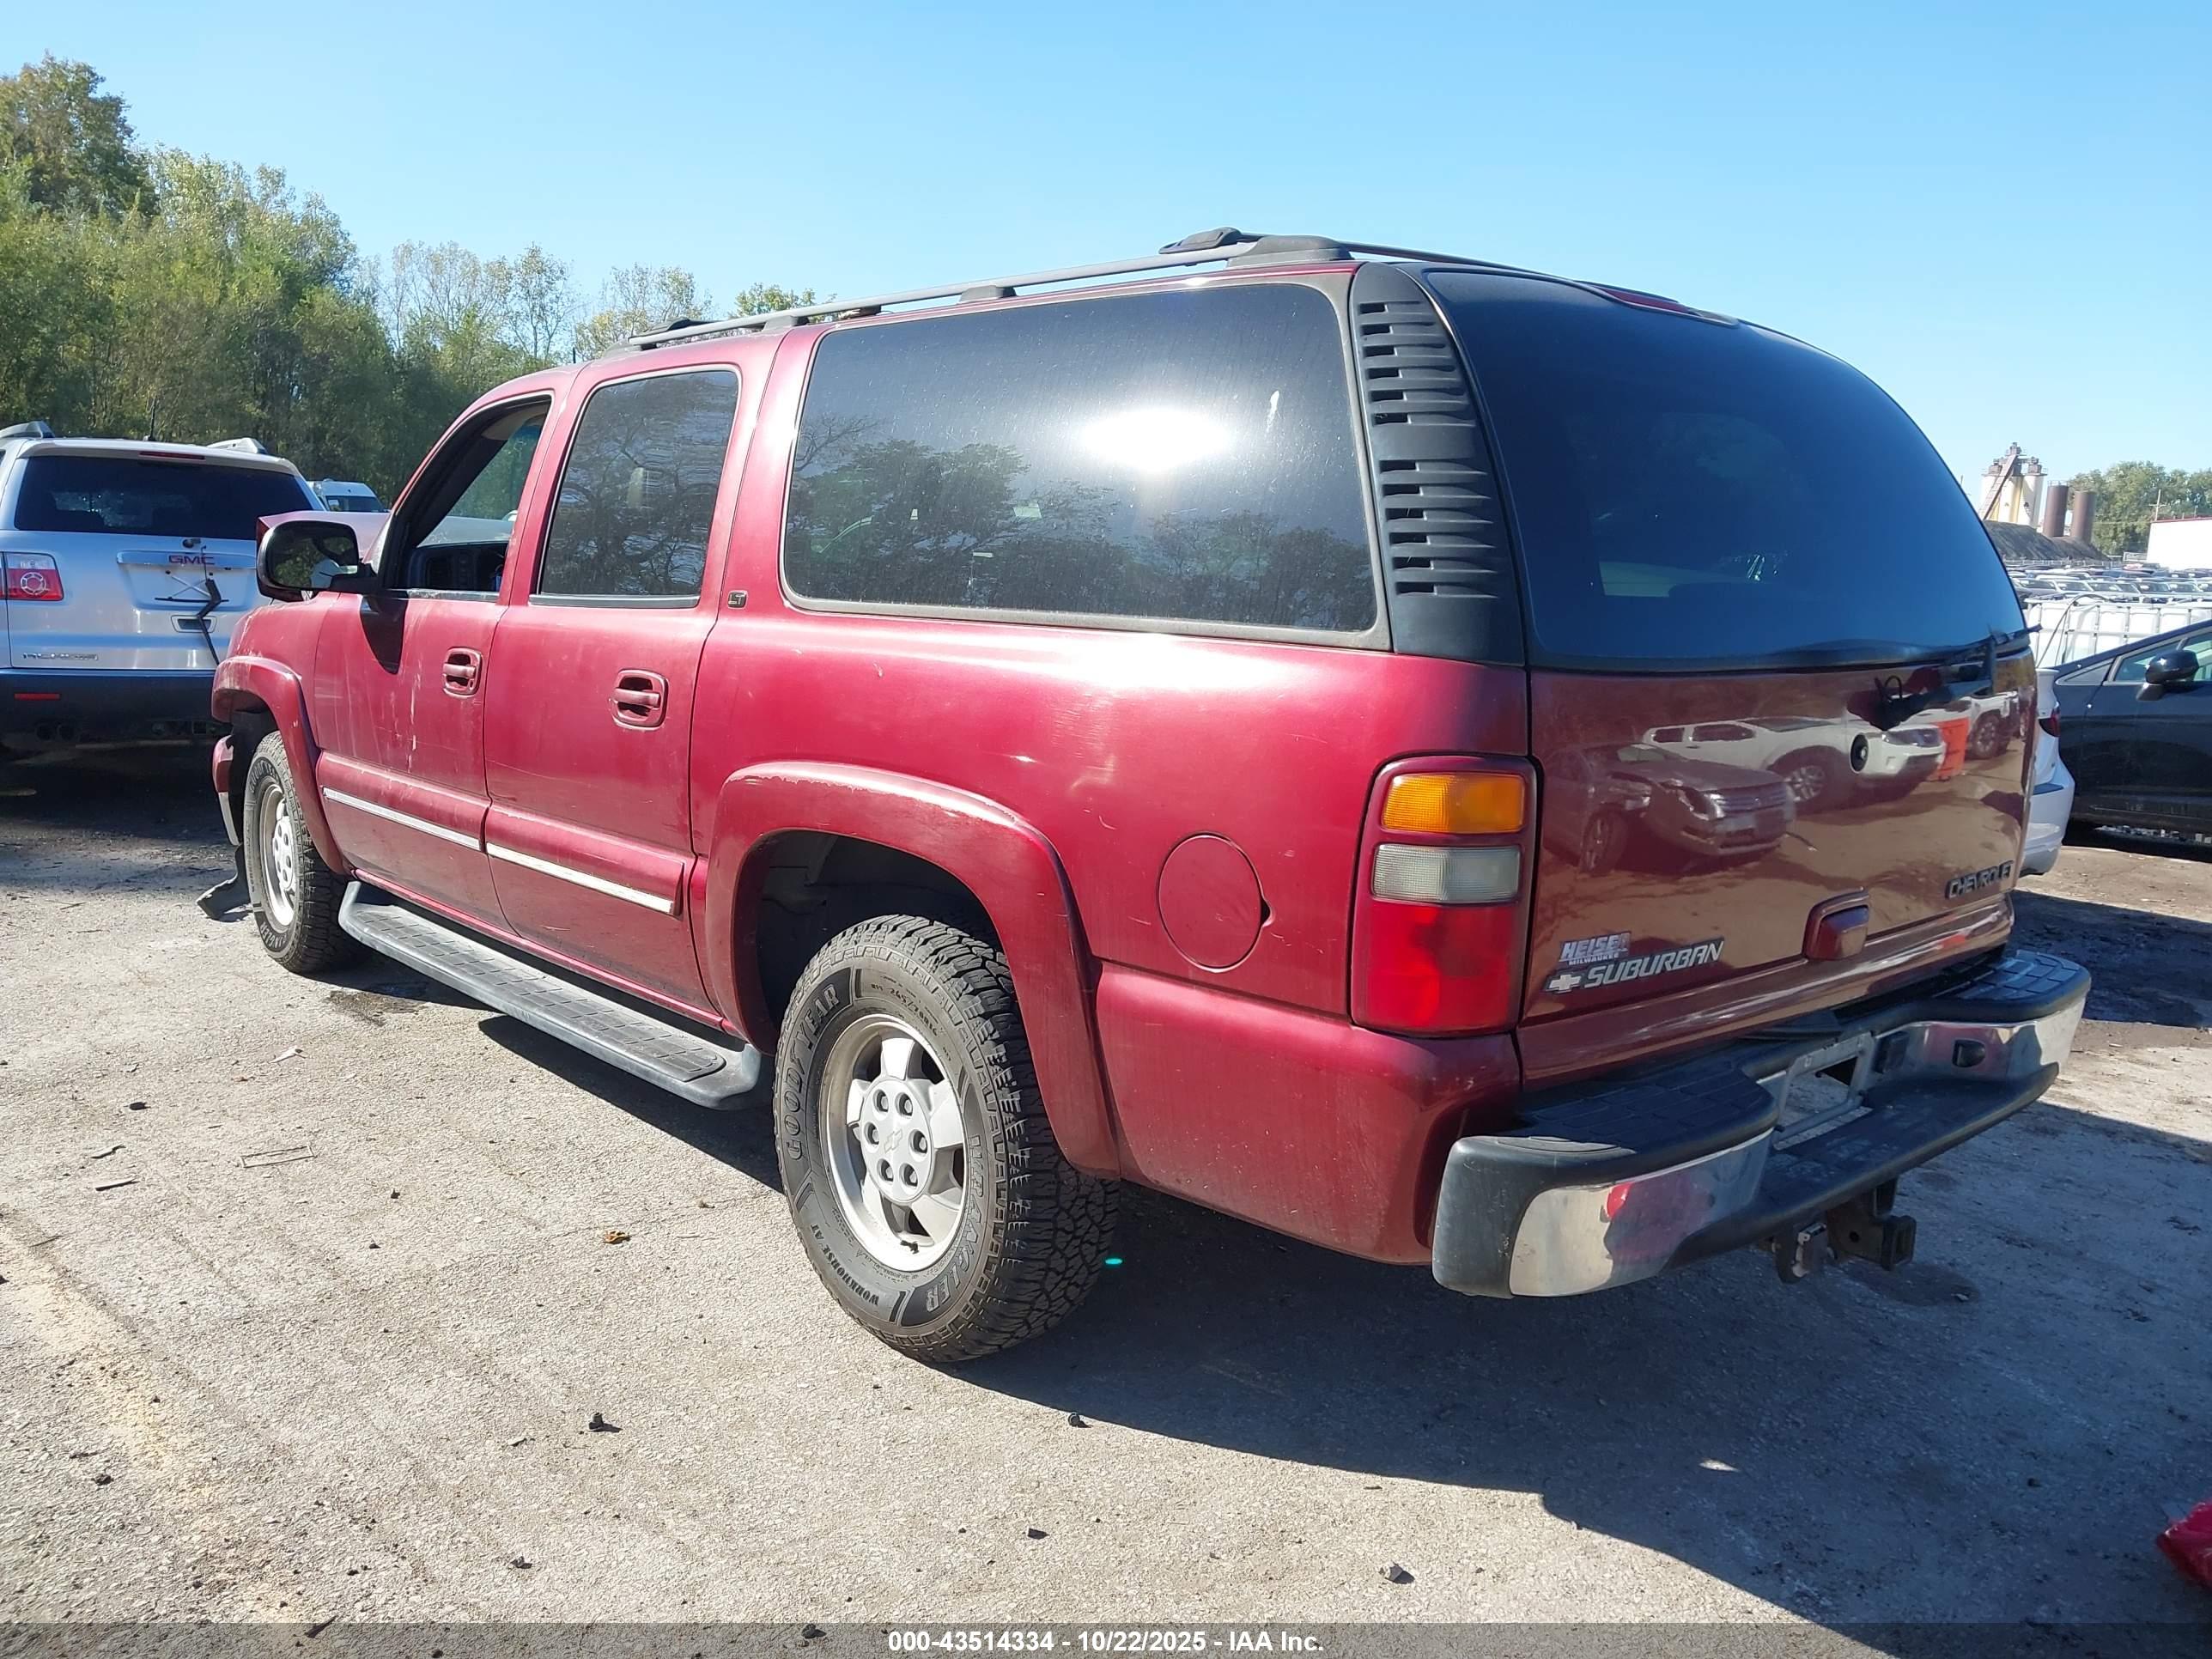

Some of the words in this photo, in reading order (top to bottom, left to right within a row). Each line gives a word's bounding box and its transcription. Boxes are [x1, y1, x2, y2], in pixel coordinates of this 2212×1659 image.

[168, 555, 216, 566] GMC
[727, 593, 746, 605] LT
[1945, 860, 2013, 900] CHEVROLET
[1584, 940, 1725, 988] SUBURBAN
[810, 1224, 824, 1241] AT
[822, 1244, 879, 1305] WORKHORSE
